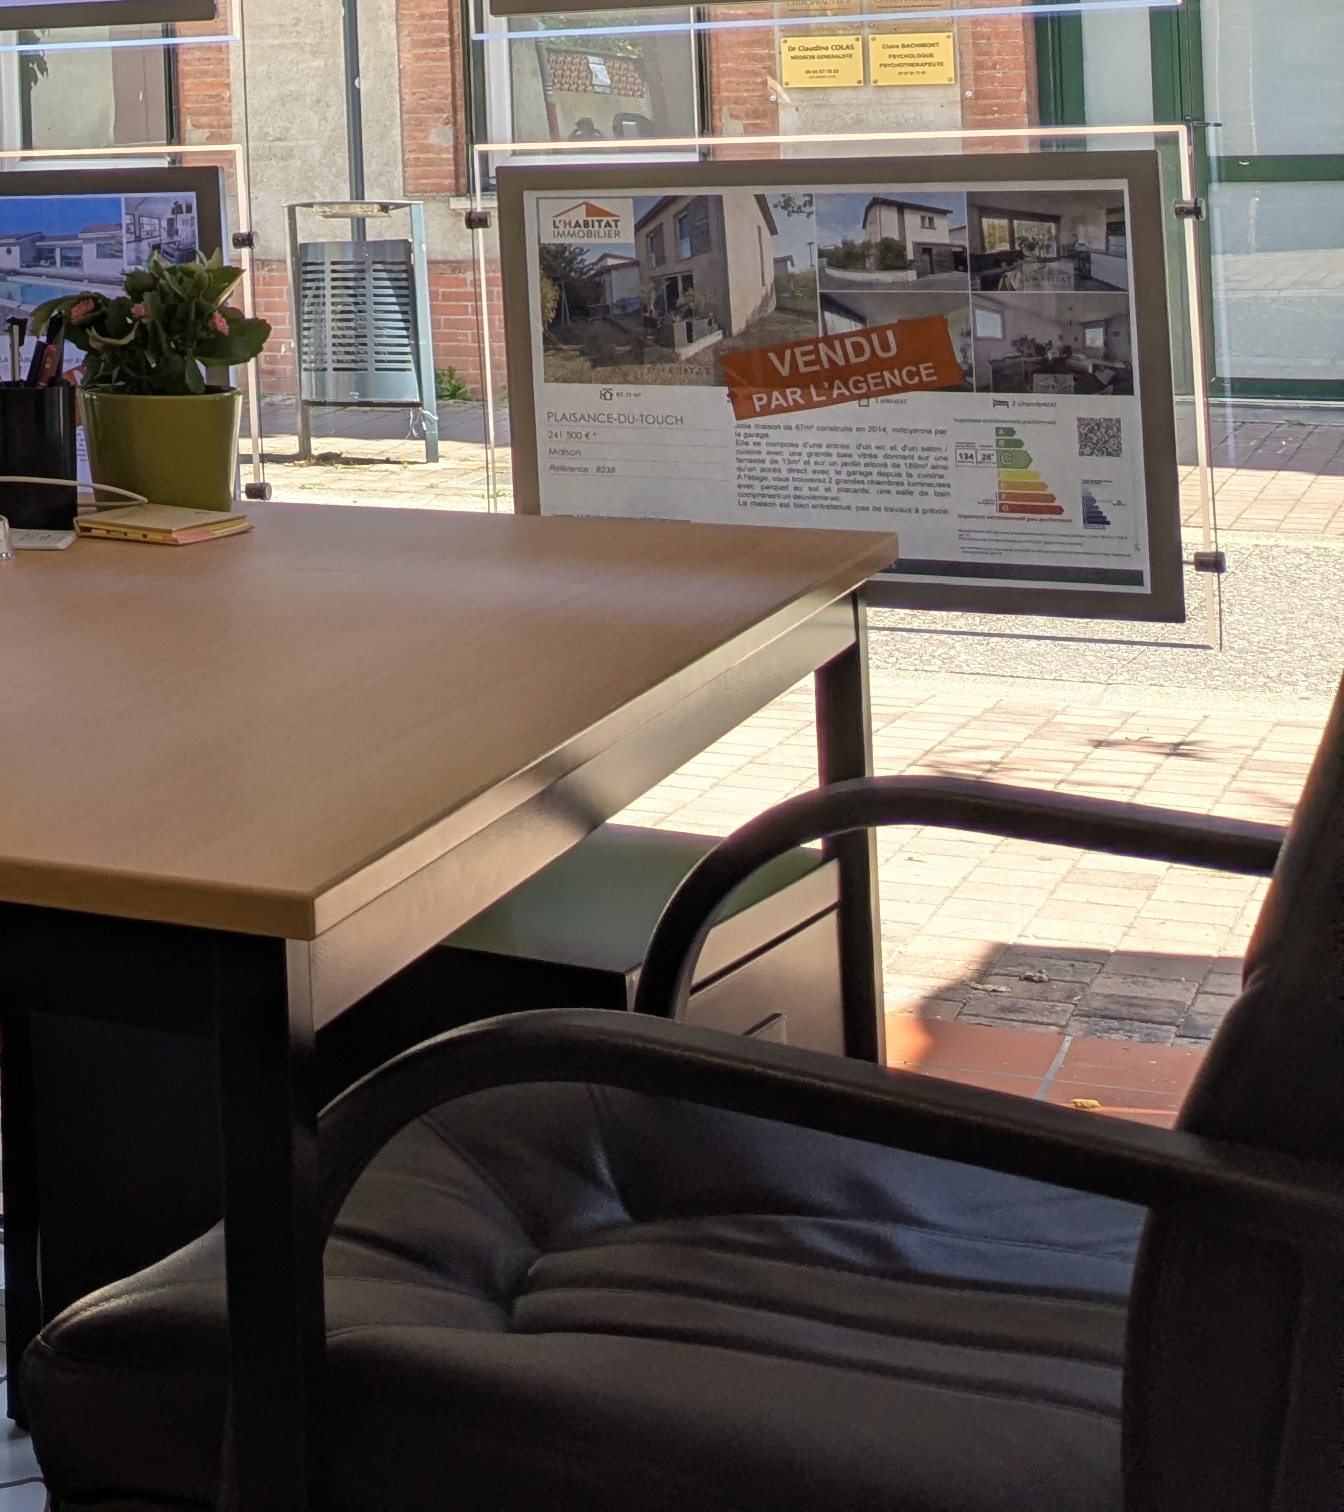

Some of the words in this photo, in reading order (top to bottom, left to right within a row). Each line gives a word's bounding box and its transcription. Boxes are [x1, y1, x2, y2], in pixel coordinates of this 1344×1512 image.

[553, 220, 620, 229] L'HABITAT
[553, 230, 621, 238] IMMOBILIER
[768, 330, 898, 378] VENDU
[752, 387, 805, 412] PAR
[809, 363, 937, 402] L'AGENCE
[547, 411, 684, 426] PLAISANCE-DU-TOUCH
